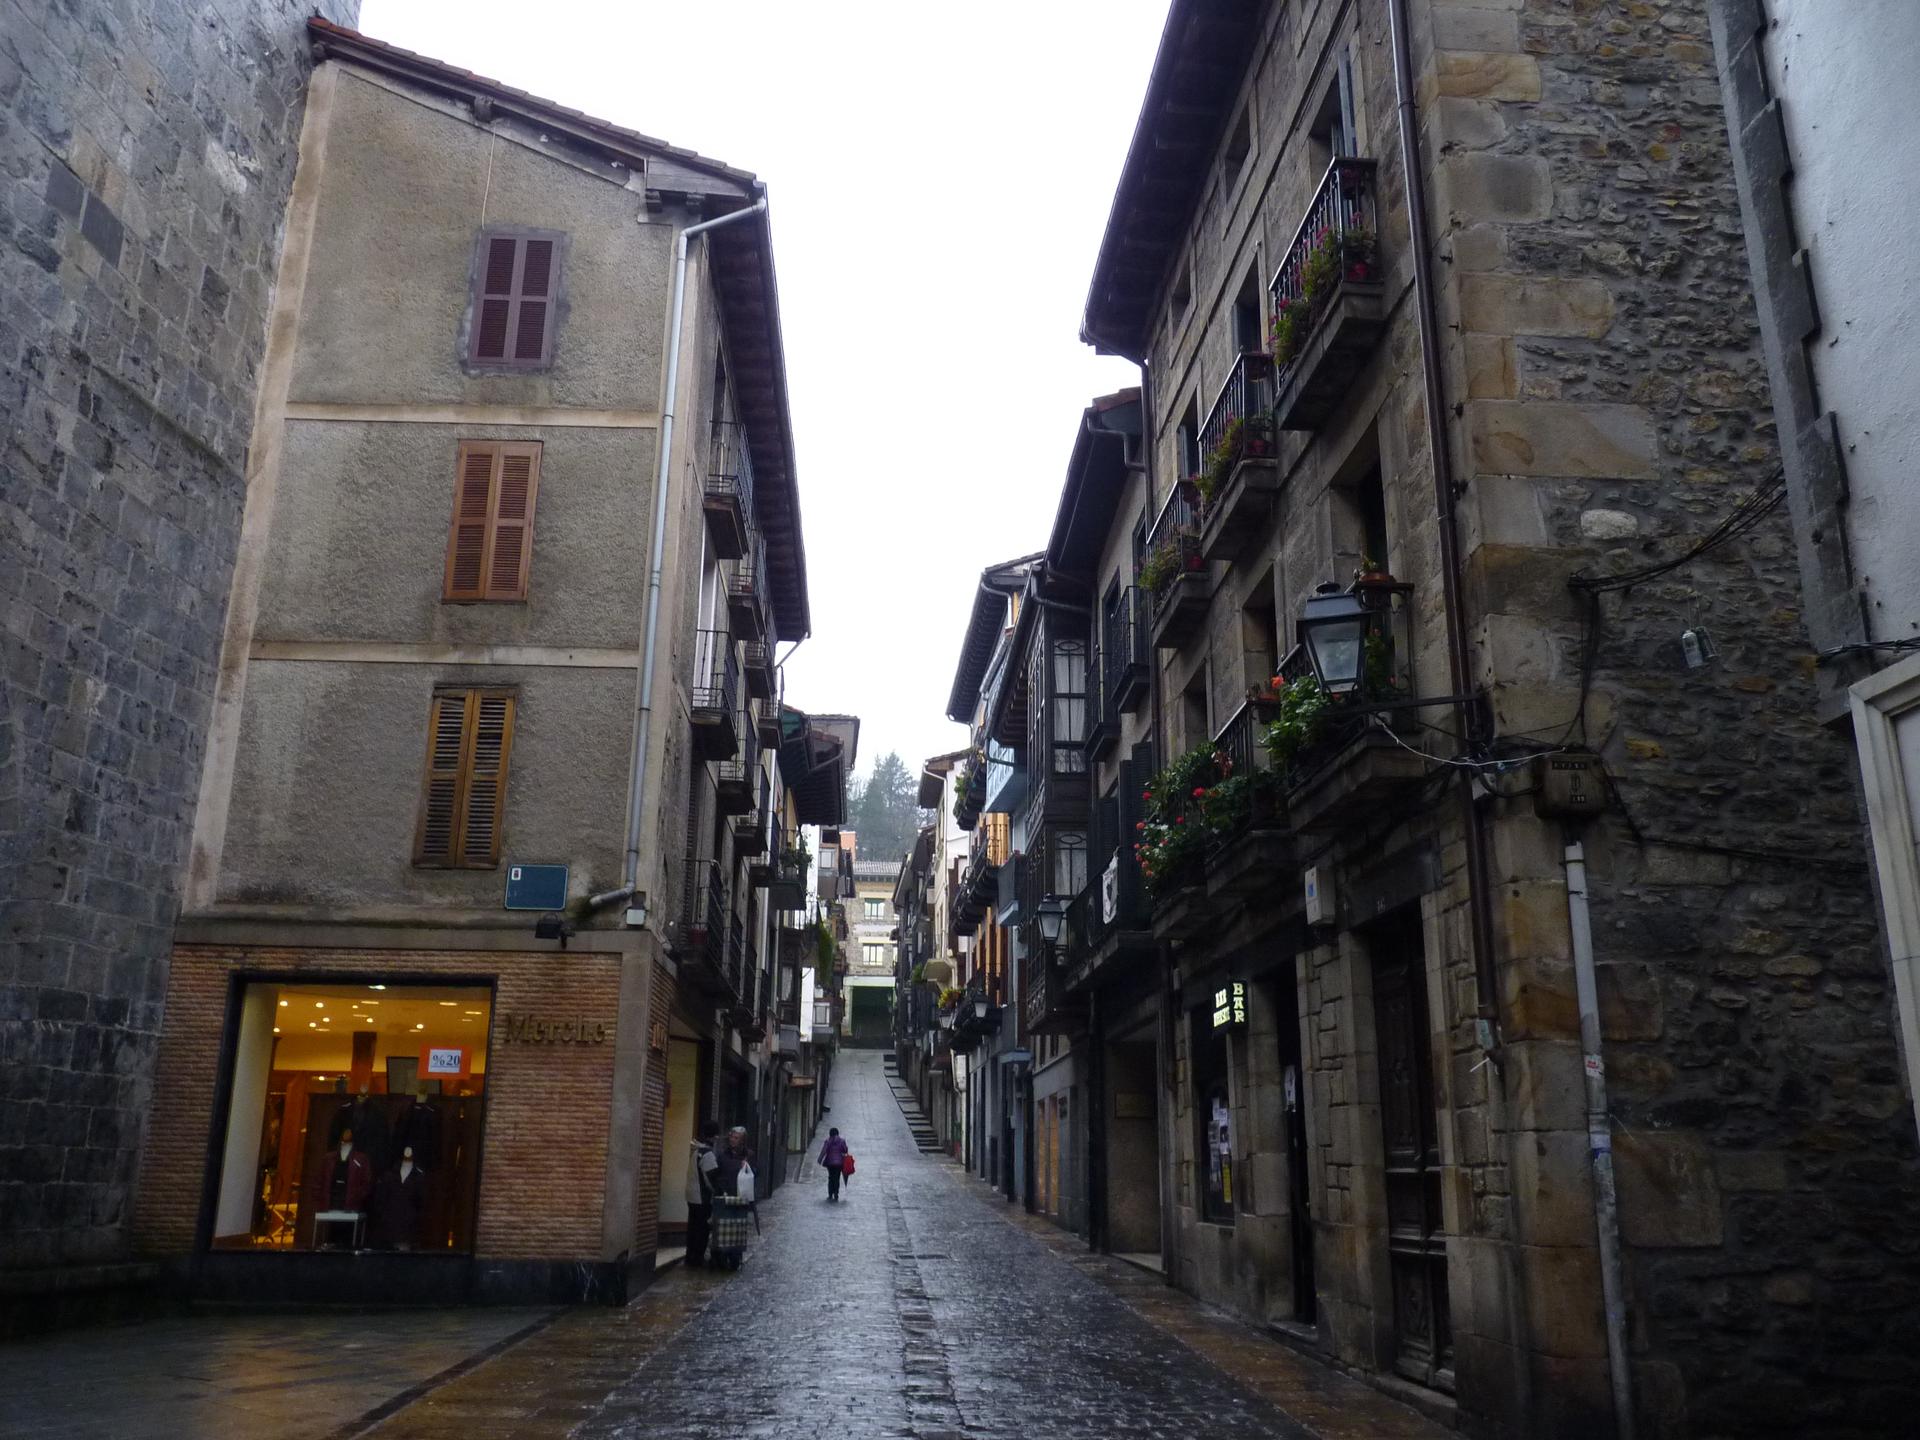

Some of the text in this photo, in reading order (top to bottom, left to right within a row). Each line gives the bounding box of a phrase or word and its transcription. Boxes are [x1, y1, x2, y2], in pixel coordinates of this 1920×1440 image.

[1232, 982, 1245, 1023] BAR
[504, 1013, 606, 1043] Merche
[432, 1054, 460, 1066] %20
